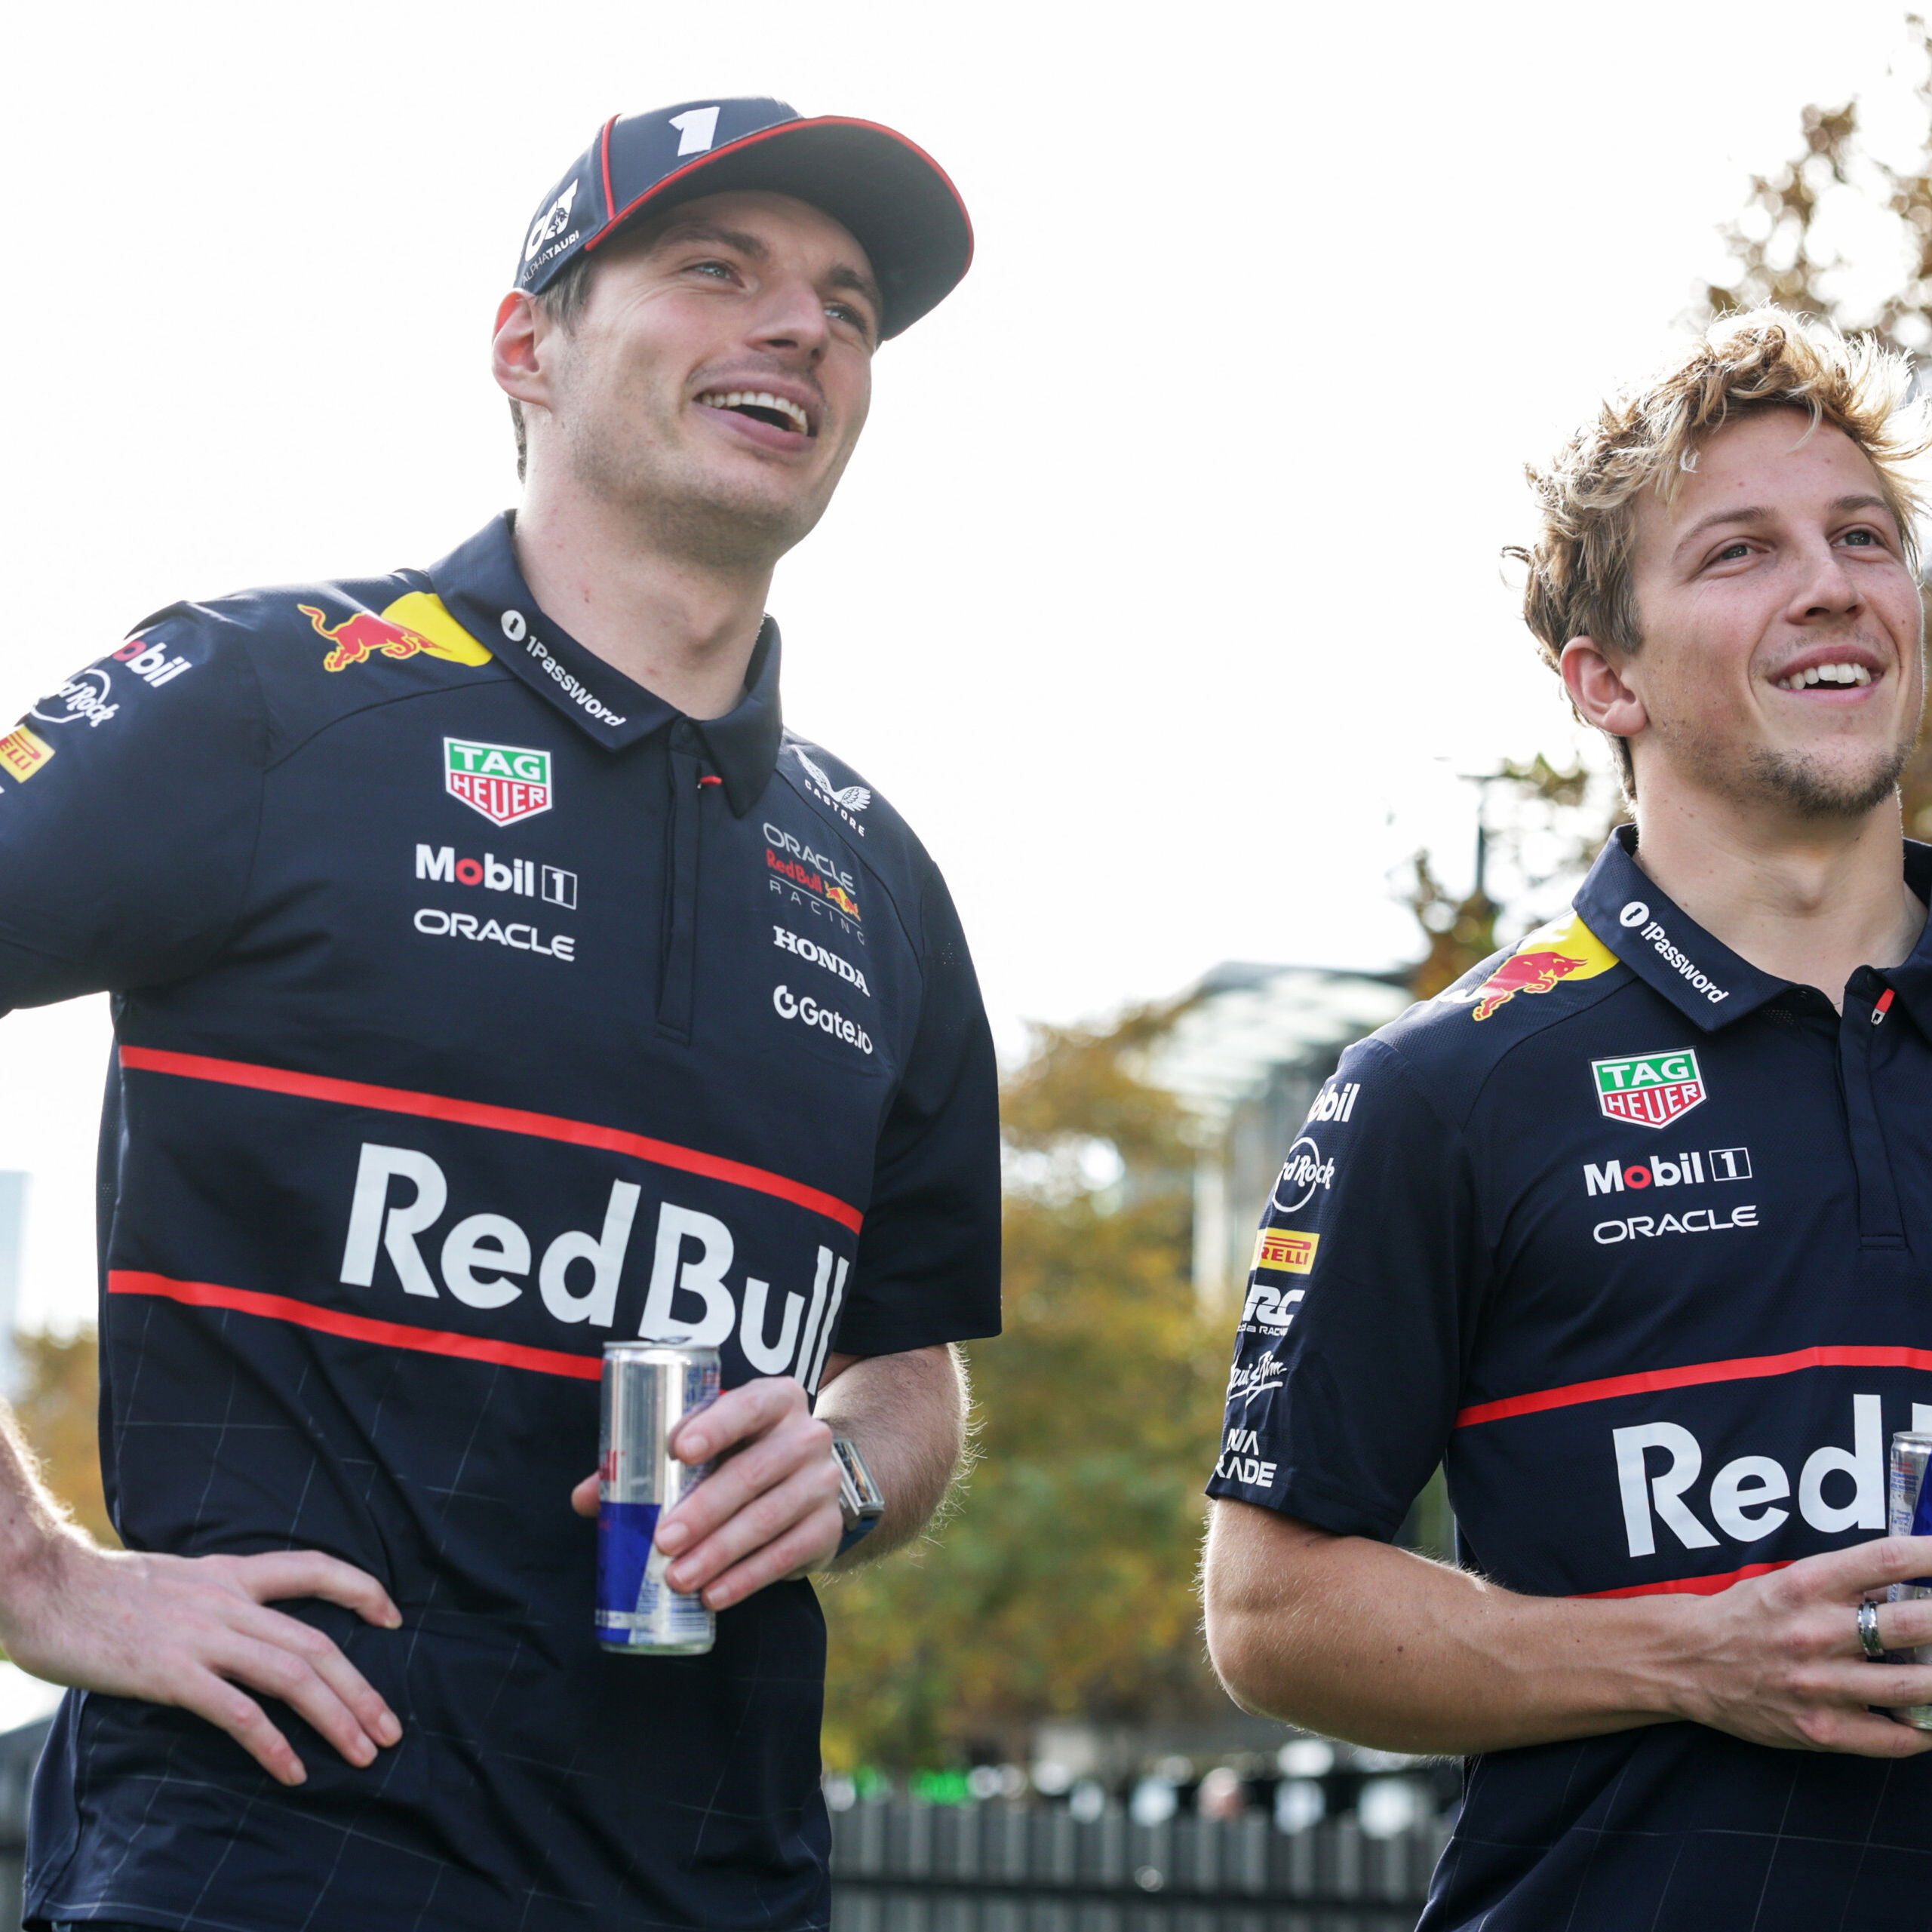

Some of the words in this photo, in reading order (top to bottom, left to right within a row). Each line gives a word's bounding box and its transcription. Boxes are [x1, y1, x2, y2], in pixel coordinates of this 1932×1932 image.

[668, 106, 720, 156] 1
[522, 230, 579, 286] ALPHATAURI
[112, 640, 192, 688] obil
[526, 636, 626, 726] 1Password
[0, 736, 32, 770] ELLI
[453, 746, 541, 780] TAG
[453, 775, 545, 819] HEUER
[804, 779, 865, 837] CASTORE
[416, 843, 534, 897] Mobil
[763, 822, 856, 895] ORACLE
[413, 908, 576, 962] ORACLE
[769, 880, 865, 946] RACING
[773, 925, 871, 997] HONDA
[1640, 921, 1729, 1003] 1Password
[800, 997, 873, 1055] Gate.io
[1602, 1058, 1691, 1087] TAG
[1307, 1083, 1360, 1123] obil
[1607, 1083, 1699, 1123] HEUER
[1583, 1151, 1705, 1196] Mobil
[1593, 1205, 1759, 1244] ORACLE
[1261, 1246, 1309, 1266] RELLI
[1242, 1284, 1305, 1326] RC
[1215, 1454, 1277, 1488] RADE
[1611, 1393, 1886, 1558] Red
